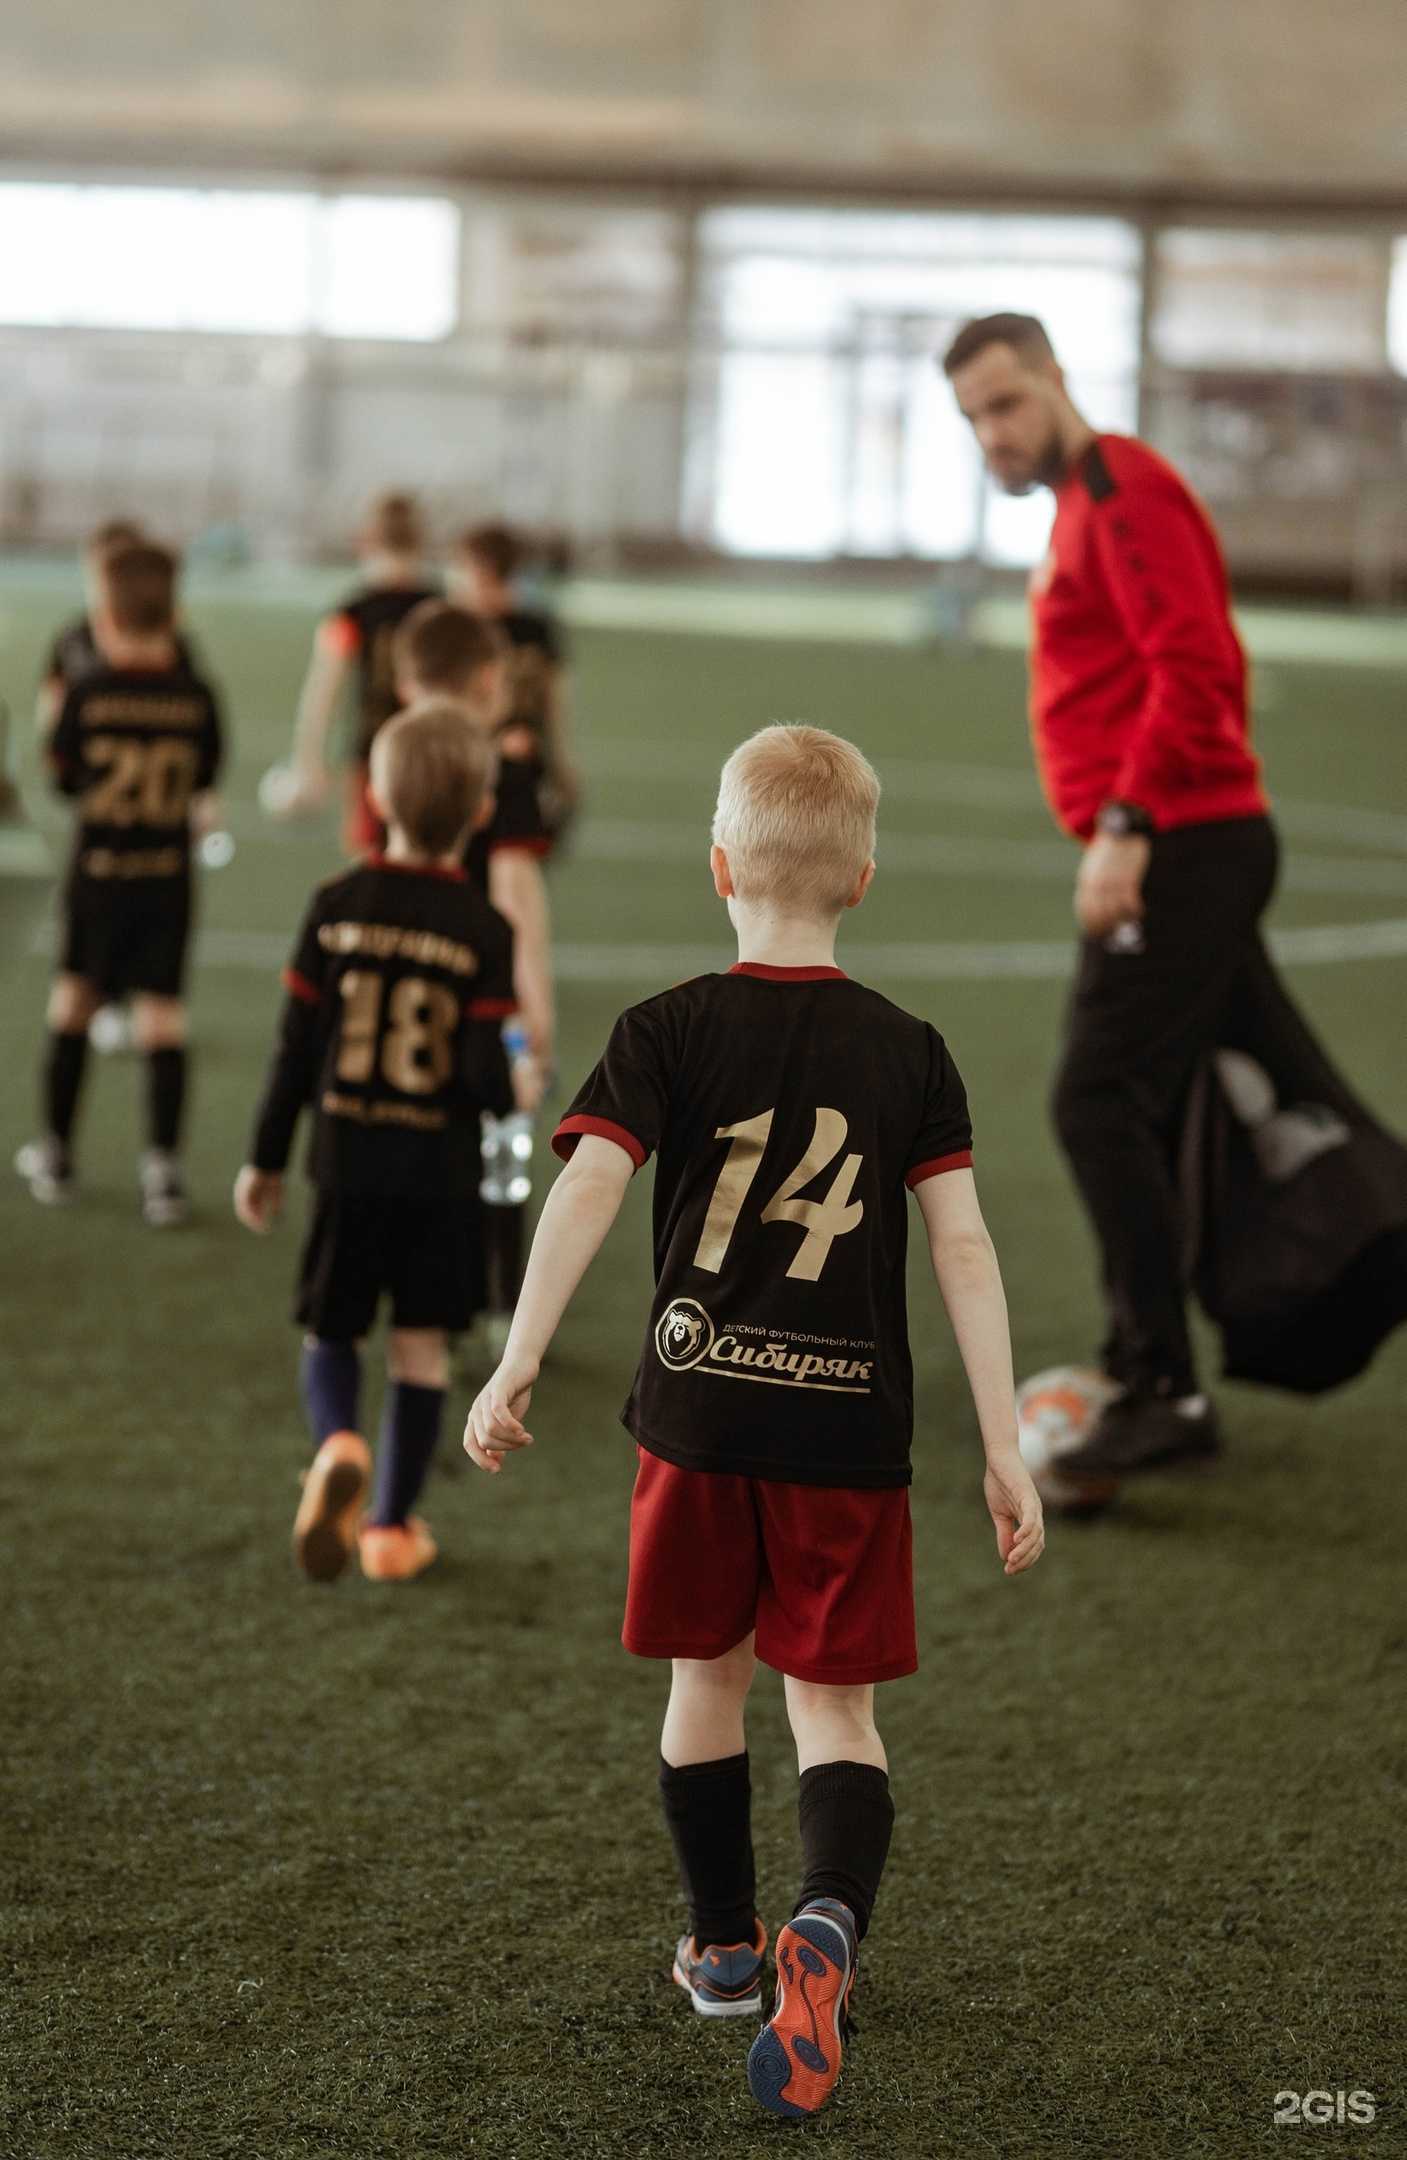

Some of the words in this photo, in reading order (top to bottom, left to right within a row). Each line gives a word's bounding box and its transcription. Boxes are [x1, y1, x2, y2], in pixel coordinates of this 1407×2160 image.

[81, 735, 194, 826] 20
[338, 971, 459, 1094] 18
[693, 1107, 864, 1281] 14
[709, 1336, 874, 1380] Сибиряк
[722, 1324, 766, 1336] ДЕТСКИЙ
[768, 1330, 847, 1347] ФУТБОЛЬНЫЙ
